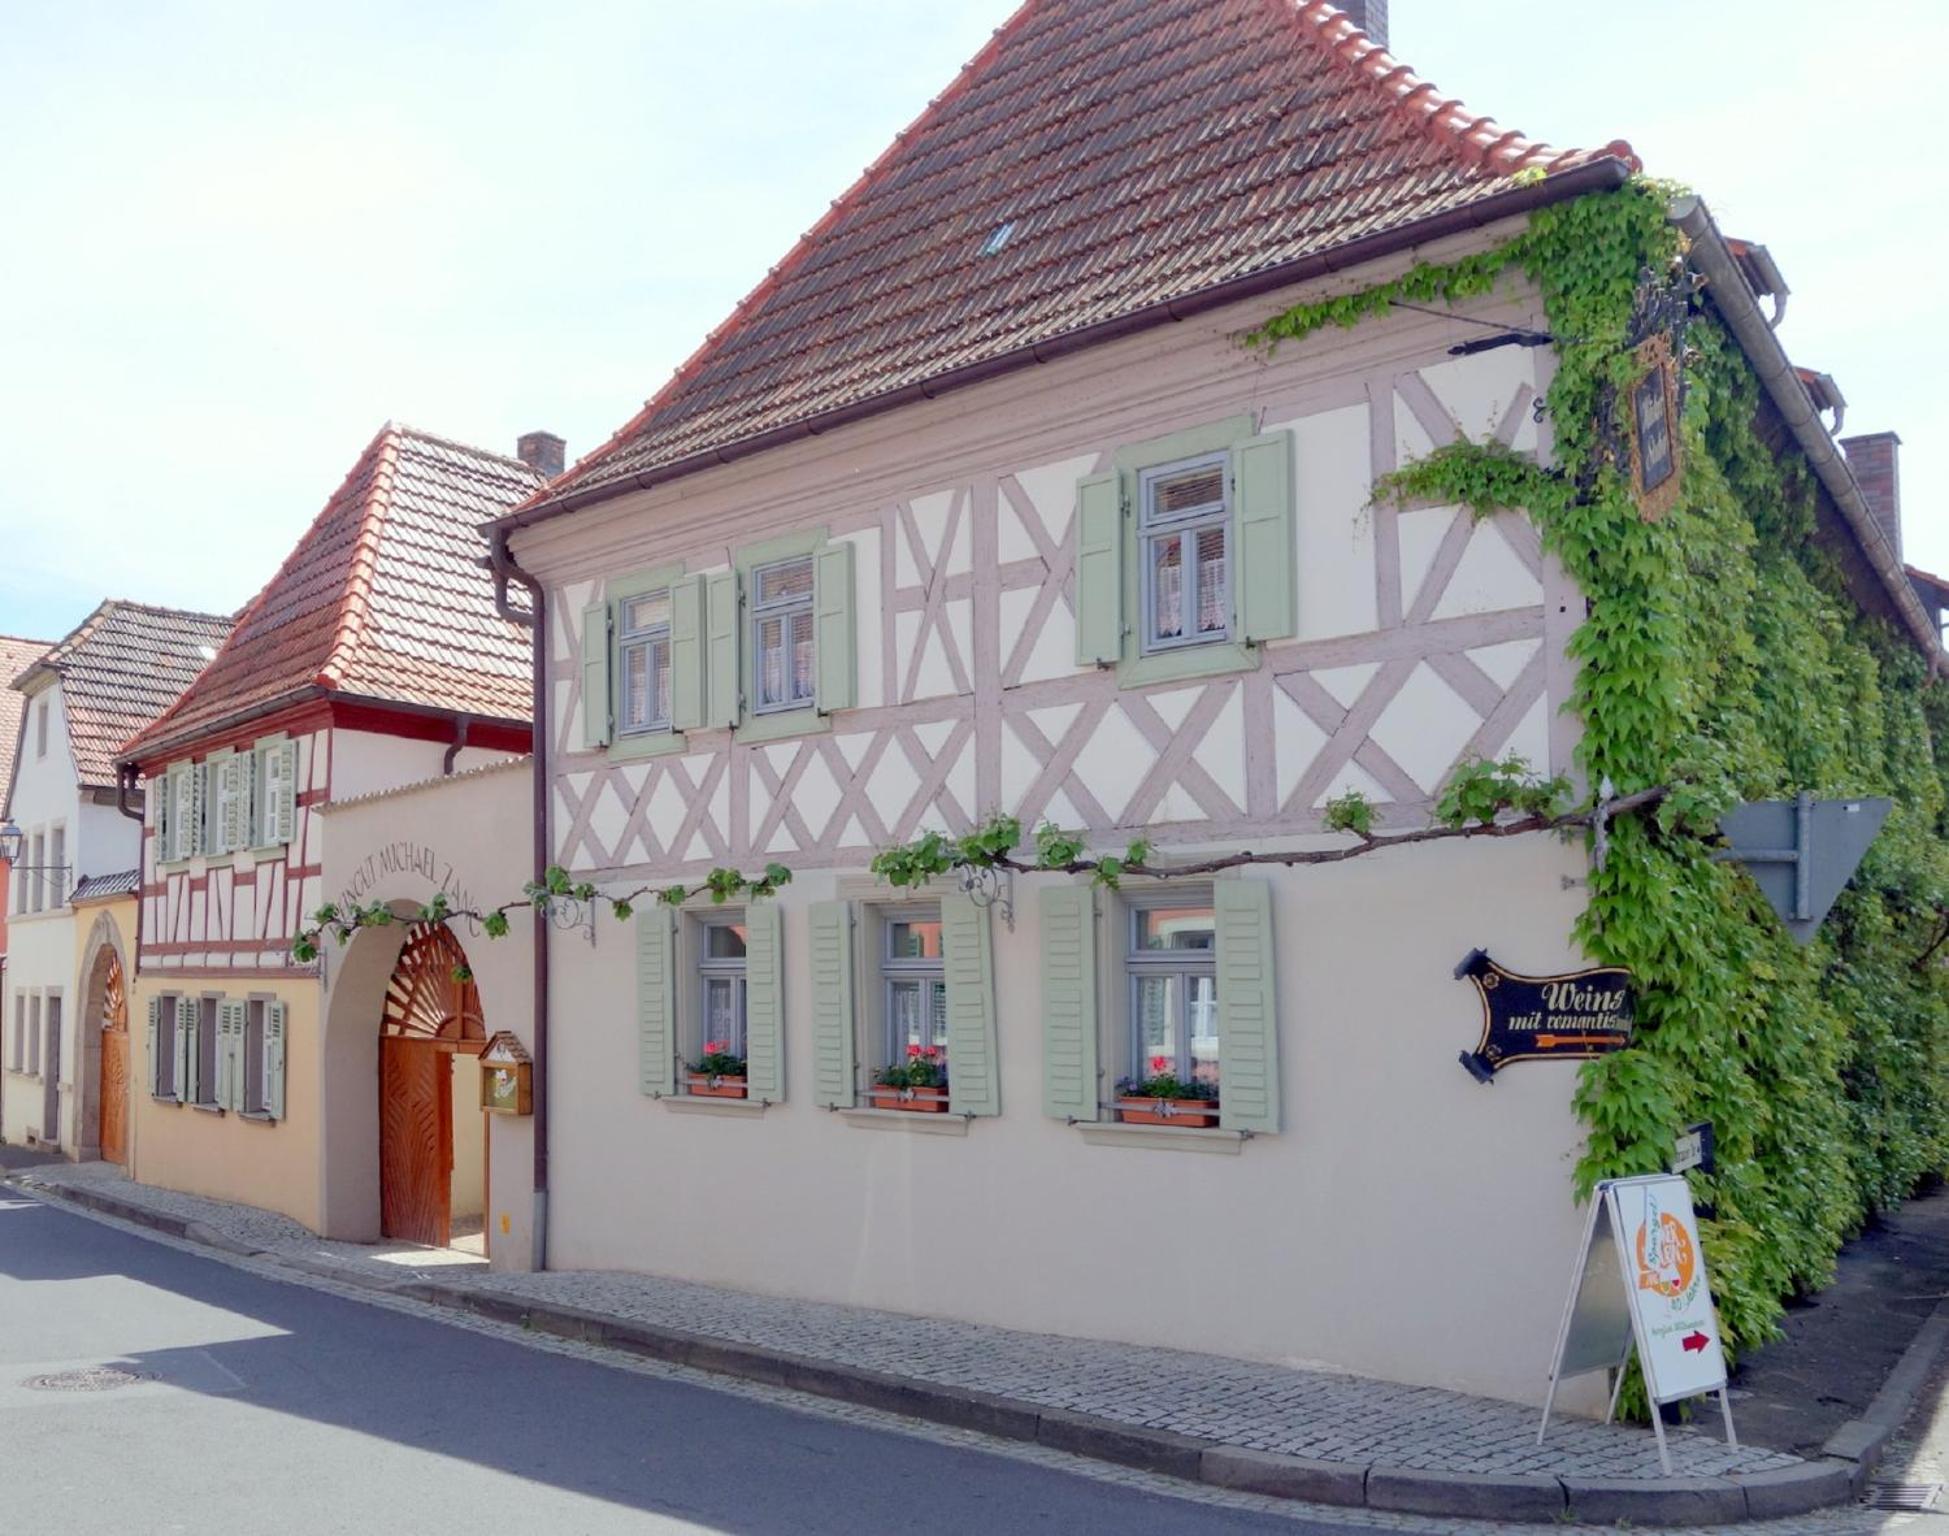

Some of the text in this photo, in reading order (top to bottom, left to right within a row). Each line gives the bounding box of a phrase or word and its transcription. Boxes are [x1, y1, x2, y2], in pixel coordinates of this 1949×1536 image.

[329, 854, 376, 939] INGUT
[379, 841, 438, 884] MICHAEL
[1508, 1011, 1542, 1031] mit
